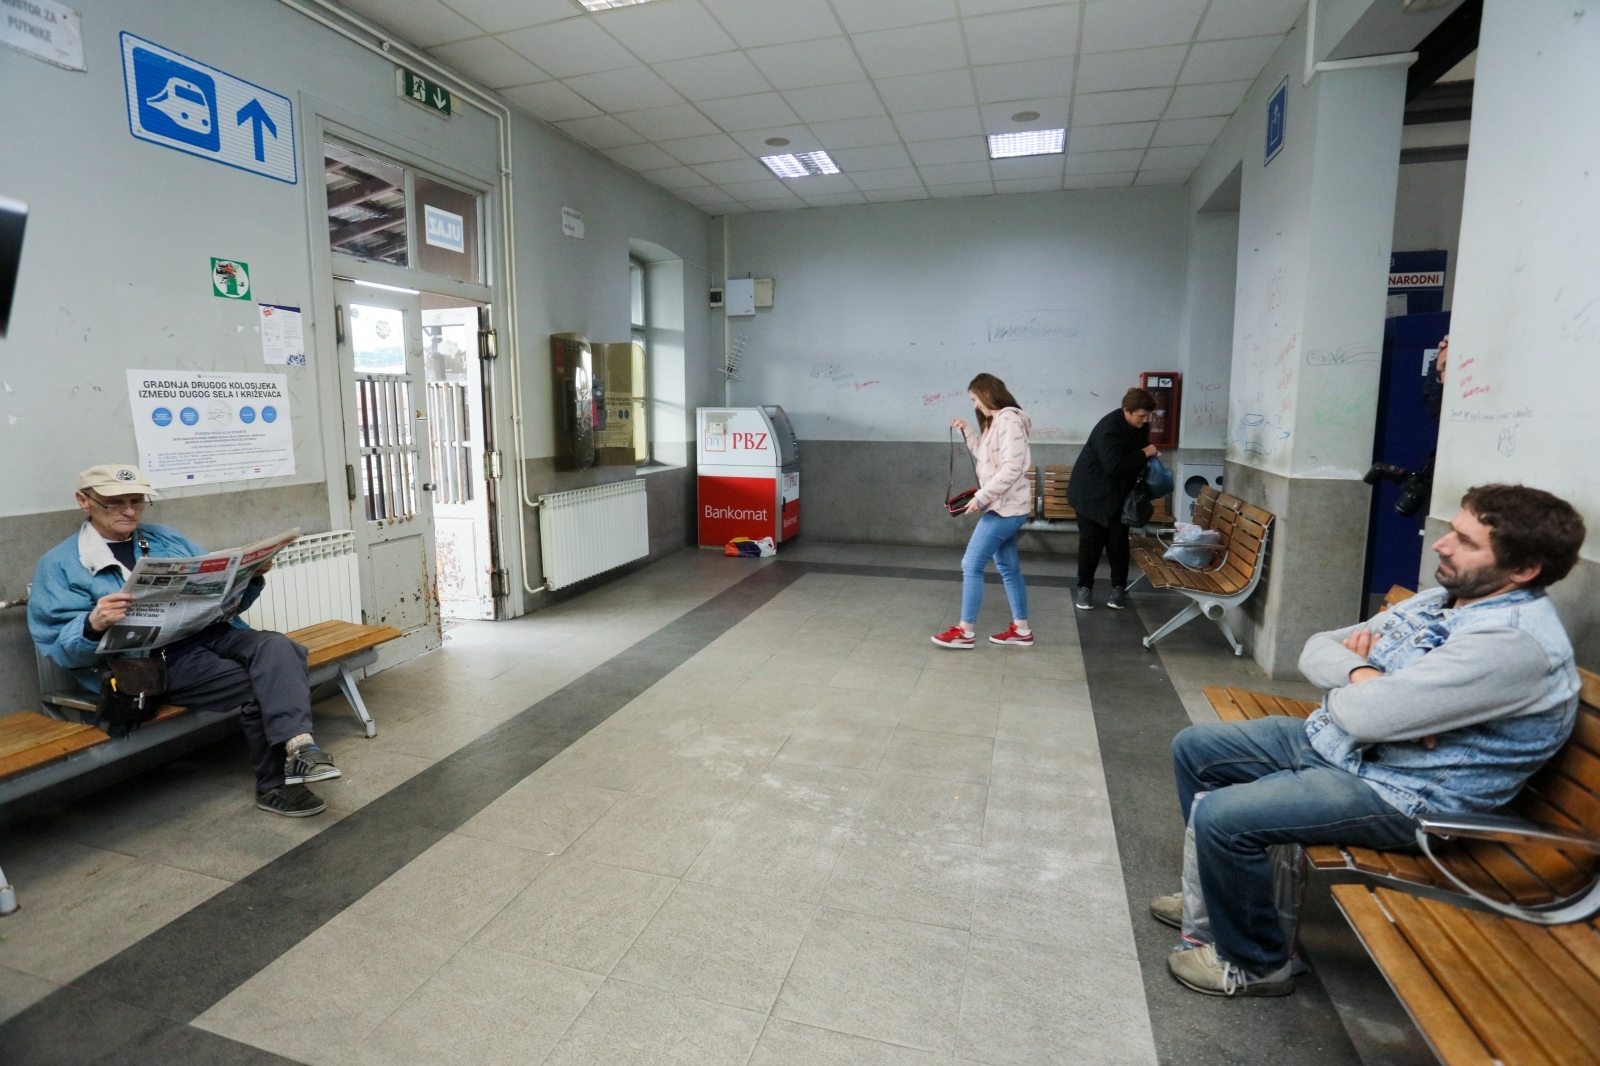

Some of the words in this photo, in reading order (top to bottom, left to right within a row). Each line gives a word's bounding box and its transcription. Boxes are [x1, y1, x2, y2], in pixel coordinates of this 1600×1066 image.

[44, 8, 58, 24] ZA
[7, 14, 53, 43] PUTNIKE
[143, 380, 190, 390] GRADNJA
[192, 381, 227, 390] DRUGOG
[229, 381, 277, 390] KOLOSIJEKA
[139, 390, 177, 398] IZMEĐU
[179, 390, 211, 398] DUGOG
[213, 390, 234, 398] SELA
[241, 389, 282, 398] KRIŽEVACA
[732, 432, 768, 450] PBZ
[789, 474, 798, 488] PBZ
[704, 505, 768, 521] Bankomat
[783, 515, 798, 528] Bankomat
